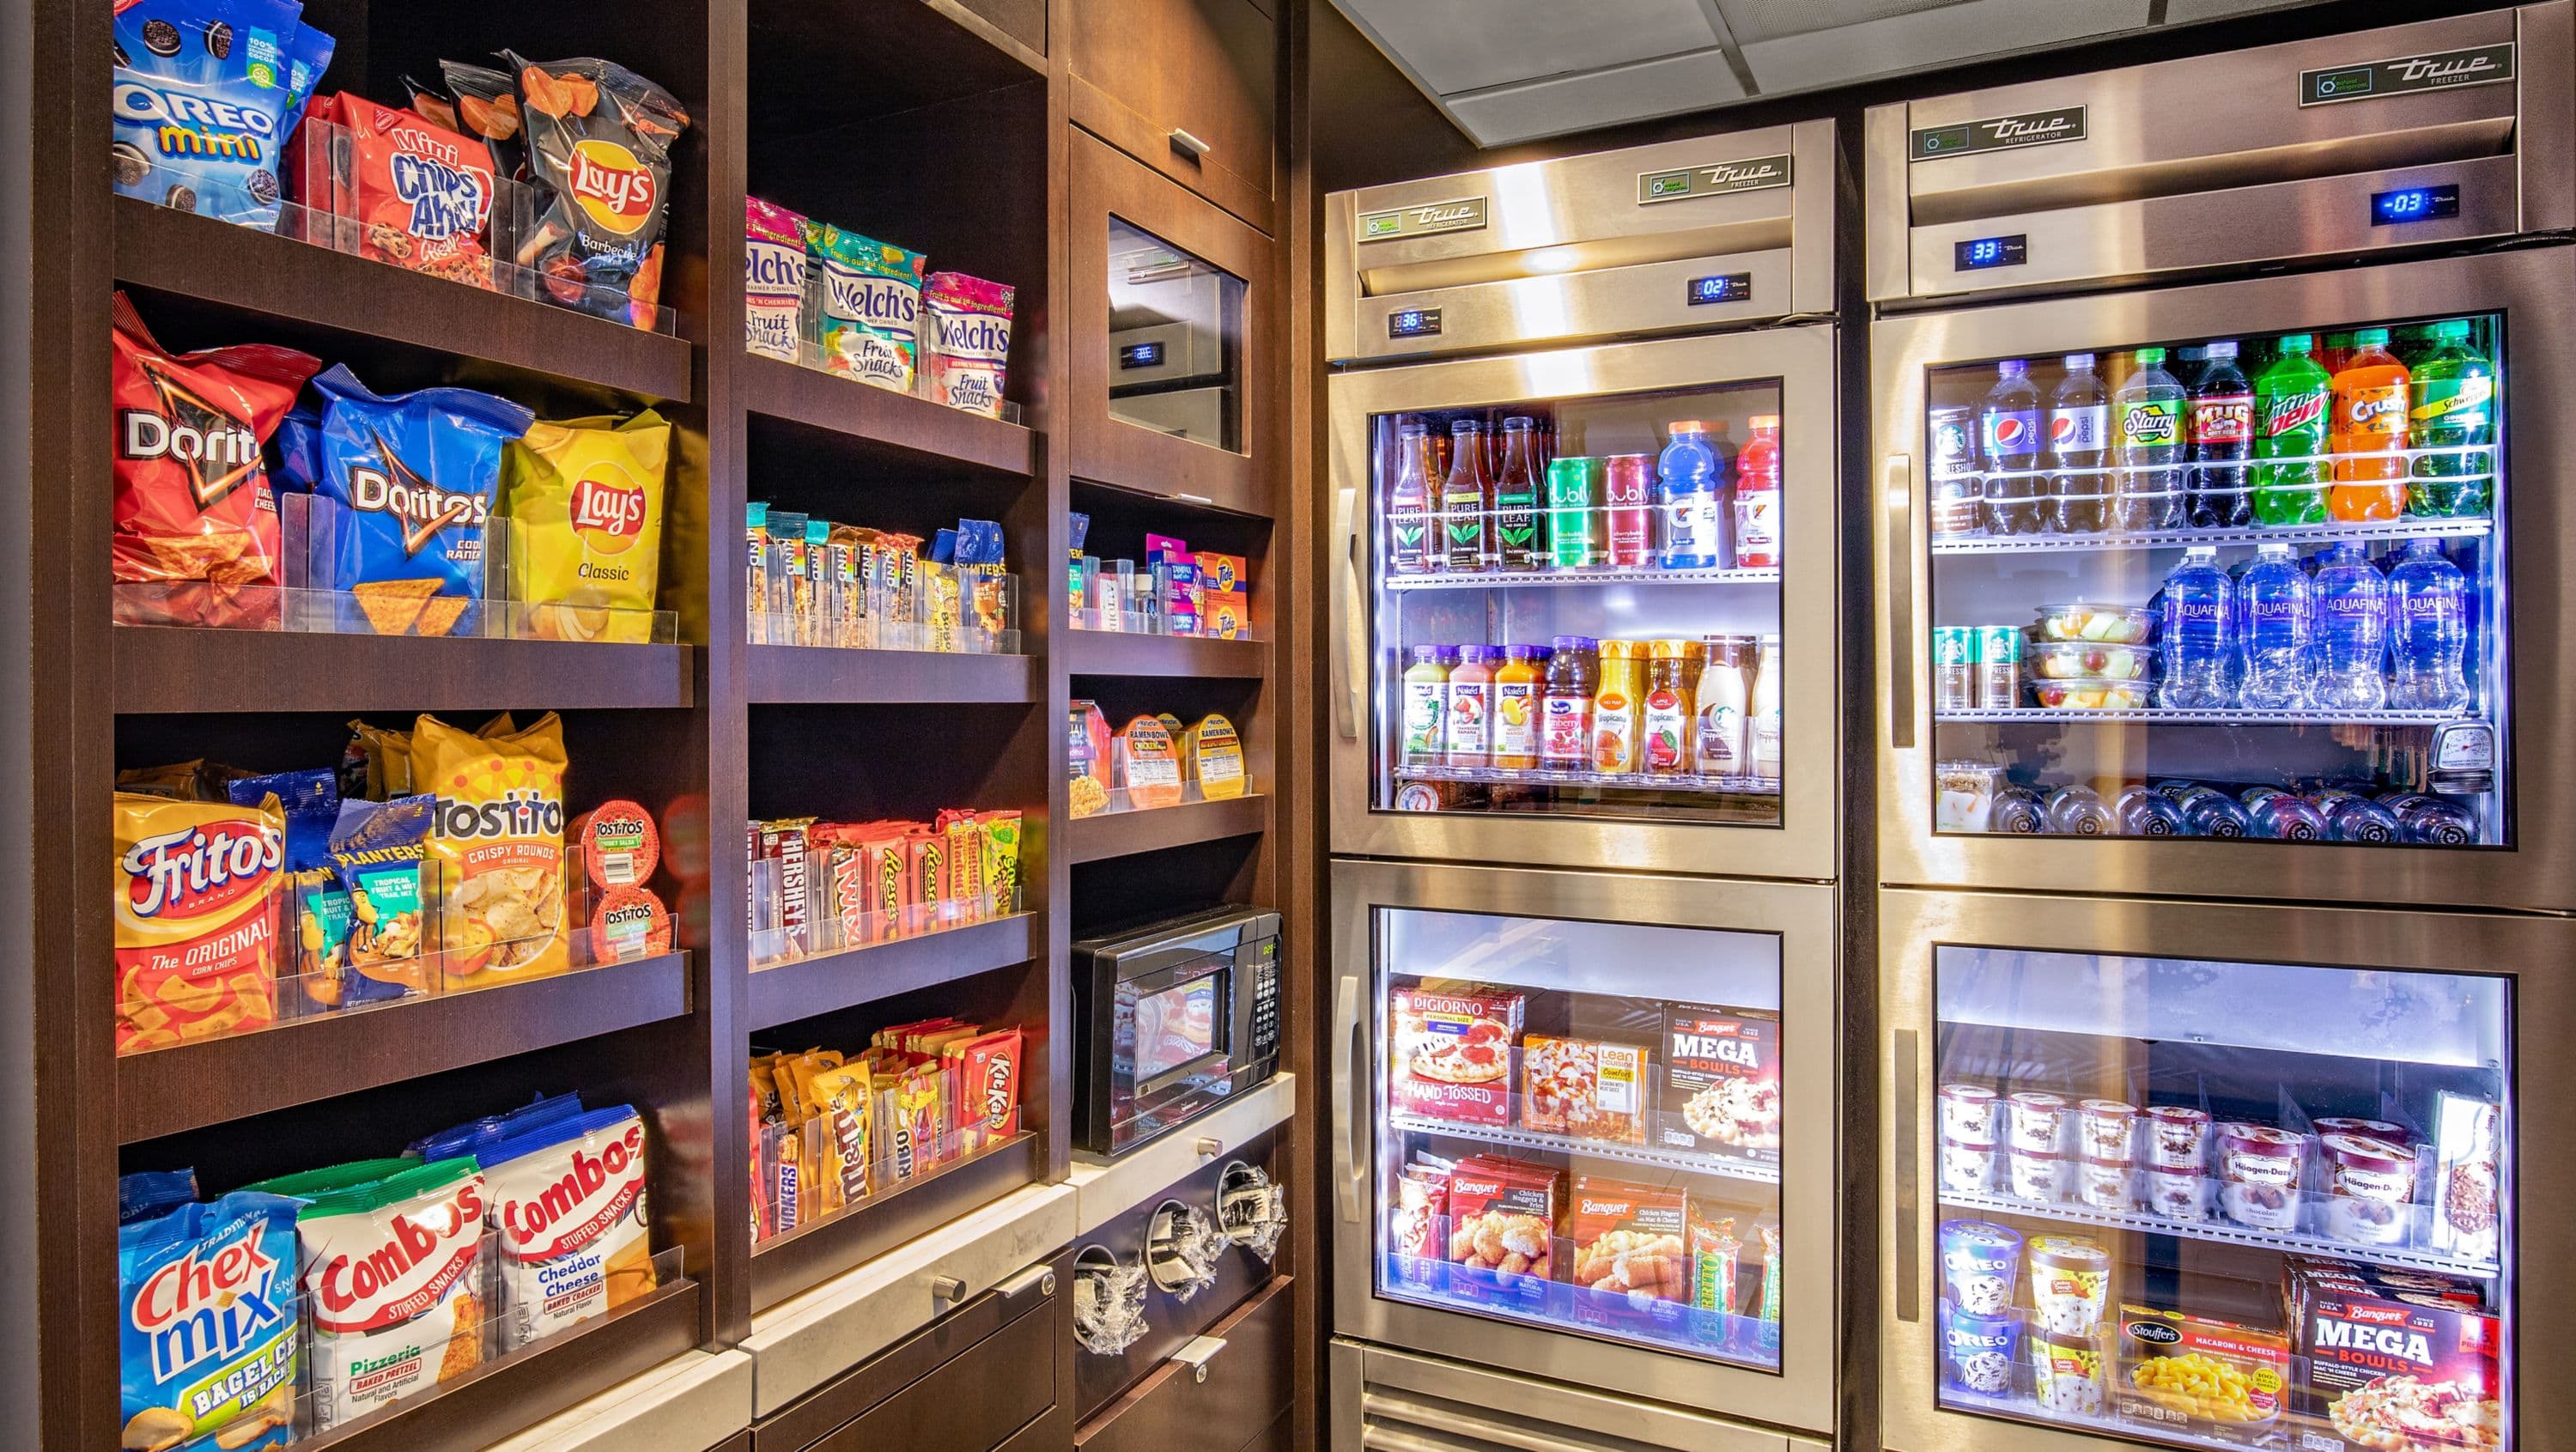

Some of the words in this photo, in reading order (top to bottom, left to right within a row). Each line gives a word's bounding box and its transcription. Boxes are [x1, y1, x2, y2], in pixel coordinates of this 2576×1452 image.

[248, 37, 275, 51] 100%
[248, 52, 275, 64] COCOA
[2388, 56, 2495, 81] true
[2431, 74, 2470, 85] FREEZER
[113, 83, 274, 133] OREO
[1982, 118, 2071, 139] true
[2005, 131, 2062, 144] REFRIGERATOR
[159, 125, 260, 161] mini
[392, 128, 459, 167] Mini
[392, 153, 478, 202] Chips
[575, 155, 651, 214] Lay's
[1700, 165, 1778, 185] true
[1731, 179, 1759, 189] FREEZER
[2384, 193, 2421, 212] -03
[1408, 207, 1474, 224] true
[582, 234, 637, 261] Barbecue
[1973, 242, 1995, 259] 33
[746, 247, 805, 288] elch's
[1703, 279, 1723, 295] 02
[829, 276, 916, 323] Welch's
[1402, 313, 1417, 327] 36
[936, 313, 1010, 354] Welch's
[960, 374, 989, 392] Fruit
[949, 386, 993, 409] Snacks
[2196, 404, 2250, 425] MUG
[2351, 398, 2406, 422] Crush
[2027, 417, 2036, 446] pepsi
[2081, 416, 2090, 445] pepsi
[2123, 410, 2178, 436] Starry
[351, 467, 487, 526] Doritos
[575, 482, 646, 537] Lay's
[579, 562, 630, 581] Classic
[837, 545, 848, 582] KIND
[863, 544, 874, 580] KIND
[885, 550, 896, 587] KIND
[904, 550, 914, 586] KIND
[1218, 566, 1233, 585] Tide
[2176, 601, 2230, 620] AQUAFINA
[2250, 600, 2306, 617] AQUAFINA
[2326, 597, 2383, 613] AQUAFINA
[2402, 595, 2460, 613] AQUAFINA
[1219, 616, 1235, 635] Tide
[1457, 686, 1480, 696] Naked
[1504, 686, 1527, 696] Naked
[1202, 729, 1220, 738] RAMEN
[596, 818, 643, 835] TOSTITOS
[468, 845, 513, 864] CRISPY
[516, 845, 556, 861] ROUNDS
[122, 825, 283, 918] Fritos
[374, 876, 410, 888] TROPICAL
[927, 841, 944, 914] Reese's
[371, 884, 393, 894] FRUIT
[781, 839, 808, 943] HERSHEY'S
[884, 848, 904, 924] Reese's
[188, 889, 236, 909] BRAND
[834, 851, 860, 948] TWIX
[605, 904, 652, 925] TOSTITOS
[151, 955, 179, 971] The
[185, 917, 273, 967] ORIGINAL
[191, 963, 213, 977] CORN
[215, 957, 238, 971] CHIPS
[1426, 1013, 1457, 1022] PERSONAL
[1699, 1022, 1736, 1033] Banquet
[1602, 1049, 1634, 1061] Lean
[1673, 1033, 1759, 1069] MEGA
[1603, 1067, 1631, 1078] Comfort
[1689, 1059, 1741, 1075] BOWLS
[504, 1123, 645, 1246] Combos
[1454, 1178, 1500, 1195] Banquet
[1512, 1195, 1537, 1204] Nuggets
[1580, 1199, 1631, 1216] Banquet
[560, 1219, 600, 1250] STUFFED
[599, 1188, 634, 1225] SNACKS
[198, 1207, 269, 1254] TRADITIONAL
[321, 1181, 484, 1312] Combos
[136, 1224, 270, 1327] Chex
[538, 1253, 602, 1286] Cheddar
[387, 1290, 428, 1321] STUFFED
[428, 1255, 465, 1302] SNACKS
[545, 1270, 599, 1298] Cheese
[546, 1296, 573, 1311] BAKED
[571, 1285, 602, 1306] CRACKER
[553, 1303, 574, 1320] Natural
[574, 1298, 593, 1311] Flavor
[2350, 1305, 2403, 1322] Banquet
[155, 1269, 277, 1377] mix
[2133, 1324, 2176, 1341] Stouffer's
[1947, 1329, 2008, 1347] OREO
[2196, 1337, 2237, 1350] MACARONI
[2246, 1346, 2276, 1356] CHEESE
[2315, 1317, 2433, 1367] MEGA
[350, 1345, 422, 1377] Pizzeria
[2313, 1359, 2360, 1372] BUFFALO-STYLE
[2360, 1368, 2386, 1377] CHICKEN
[2338, 1349, 2409, 1372] BOWLS
[355, 1373, 385, 1391] BAKED
[385, 1363, 420, 1384] PRETZEL
[2335, 1369, 2357, 1377] CHEESE
[195, 1352, 273, 1419] BAGEL
[351, 1388, 377, 1403] Natural
[378, 1384, 391, 1395] and
[392, 1374, 420, 1392] Artificial
[374, 1388, 398, 1404] Flavors
[240, 1389, 257, 1410] IS
